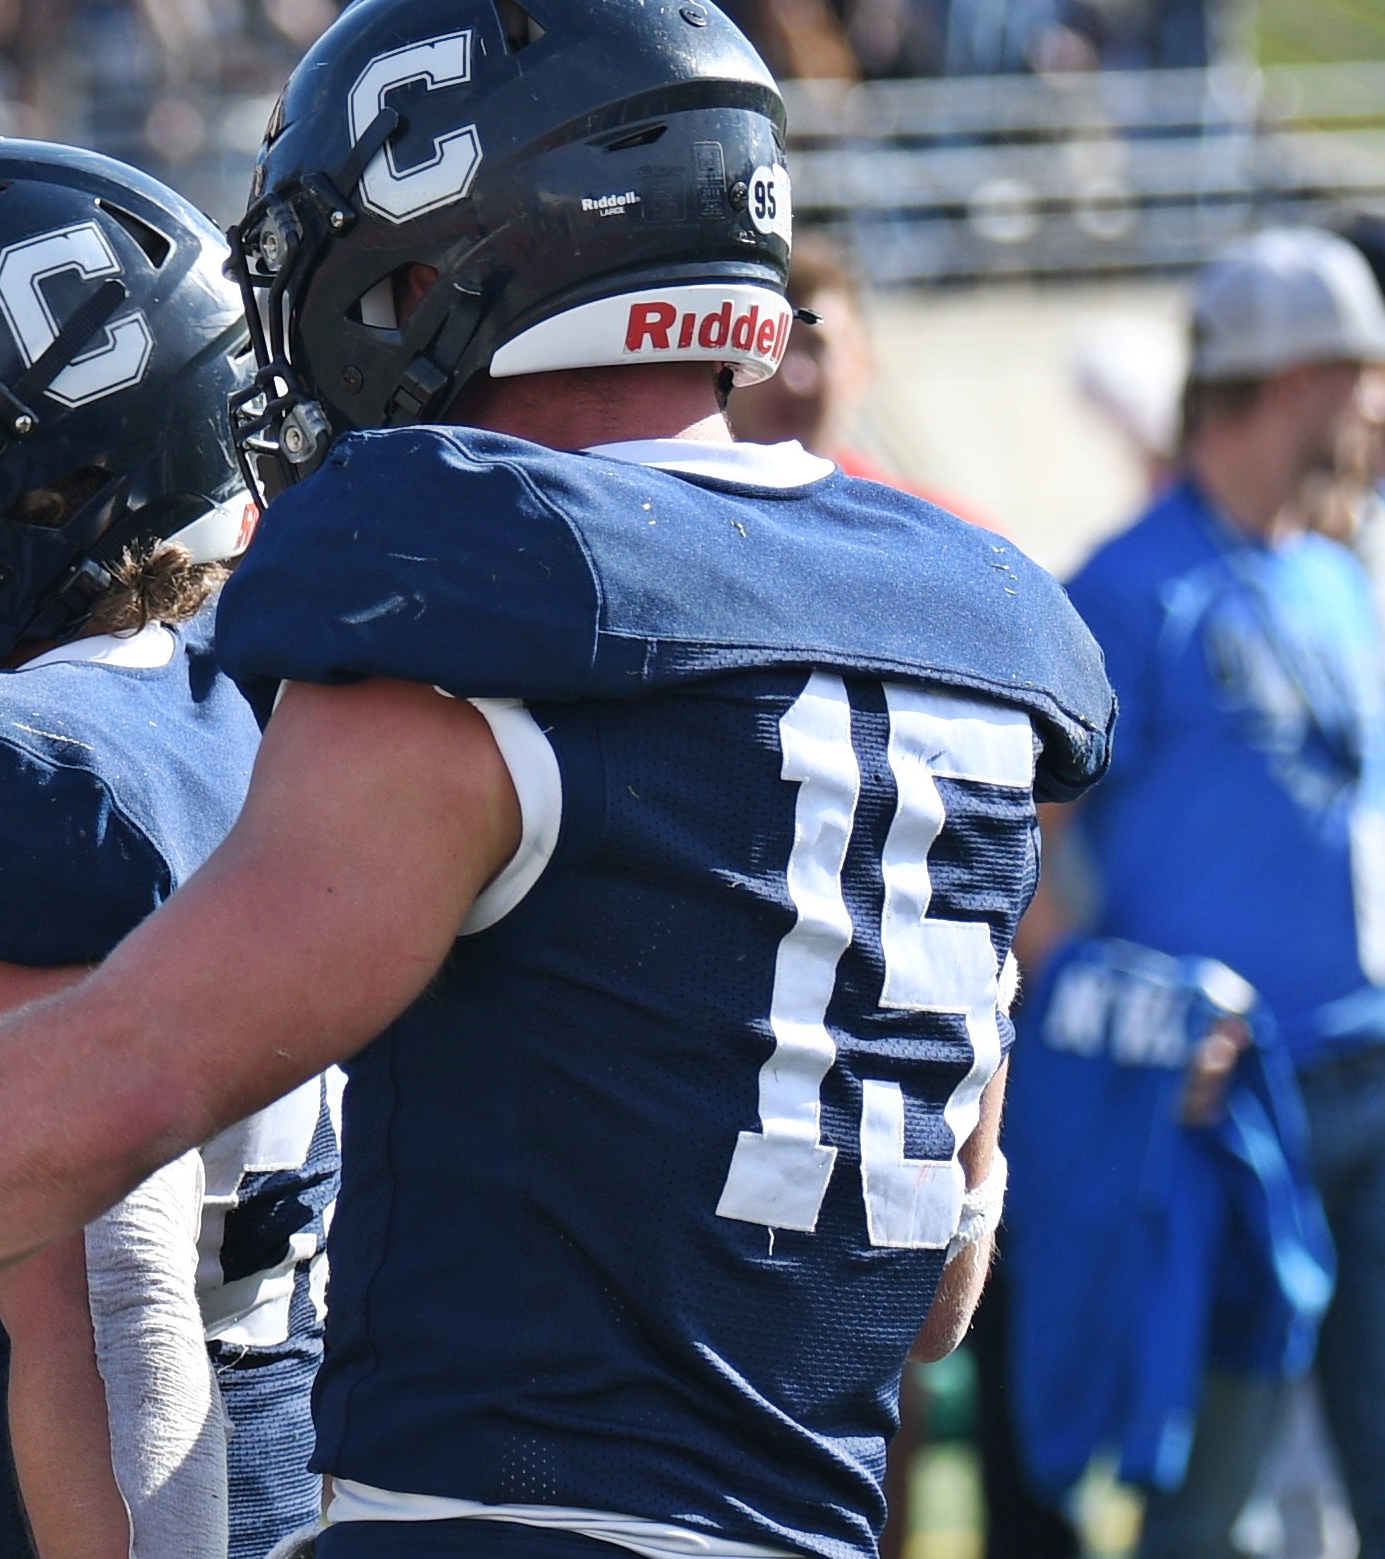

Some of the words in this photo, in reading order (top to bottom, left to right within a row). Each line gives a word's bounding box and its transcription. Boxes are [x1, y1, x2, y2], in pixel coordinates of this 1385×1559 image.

[347, 29, 483, 224] C
[581, 191, 636, 211] Riddell
[755, 180, 776, 220] 95
[624, 301, 790, 362] Riddell
[715, 668, 1034, 1250] 15
